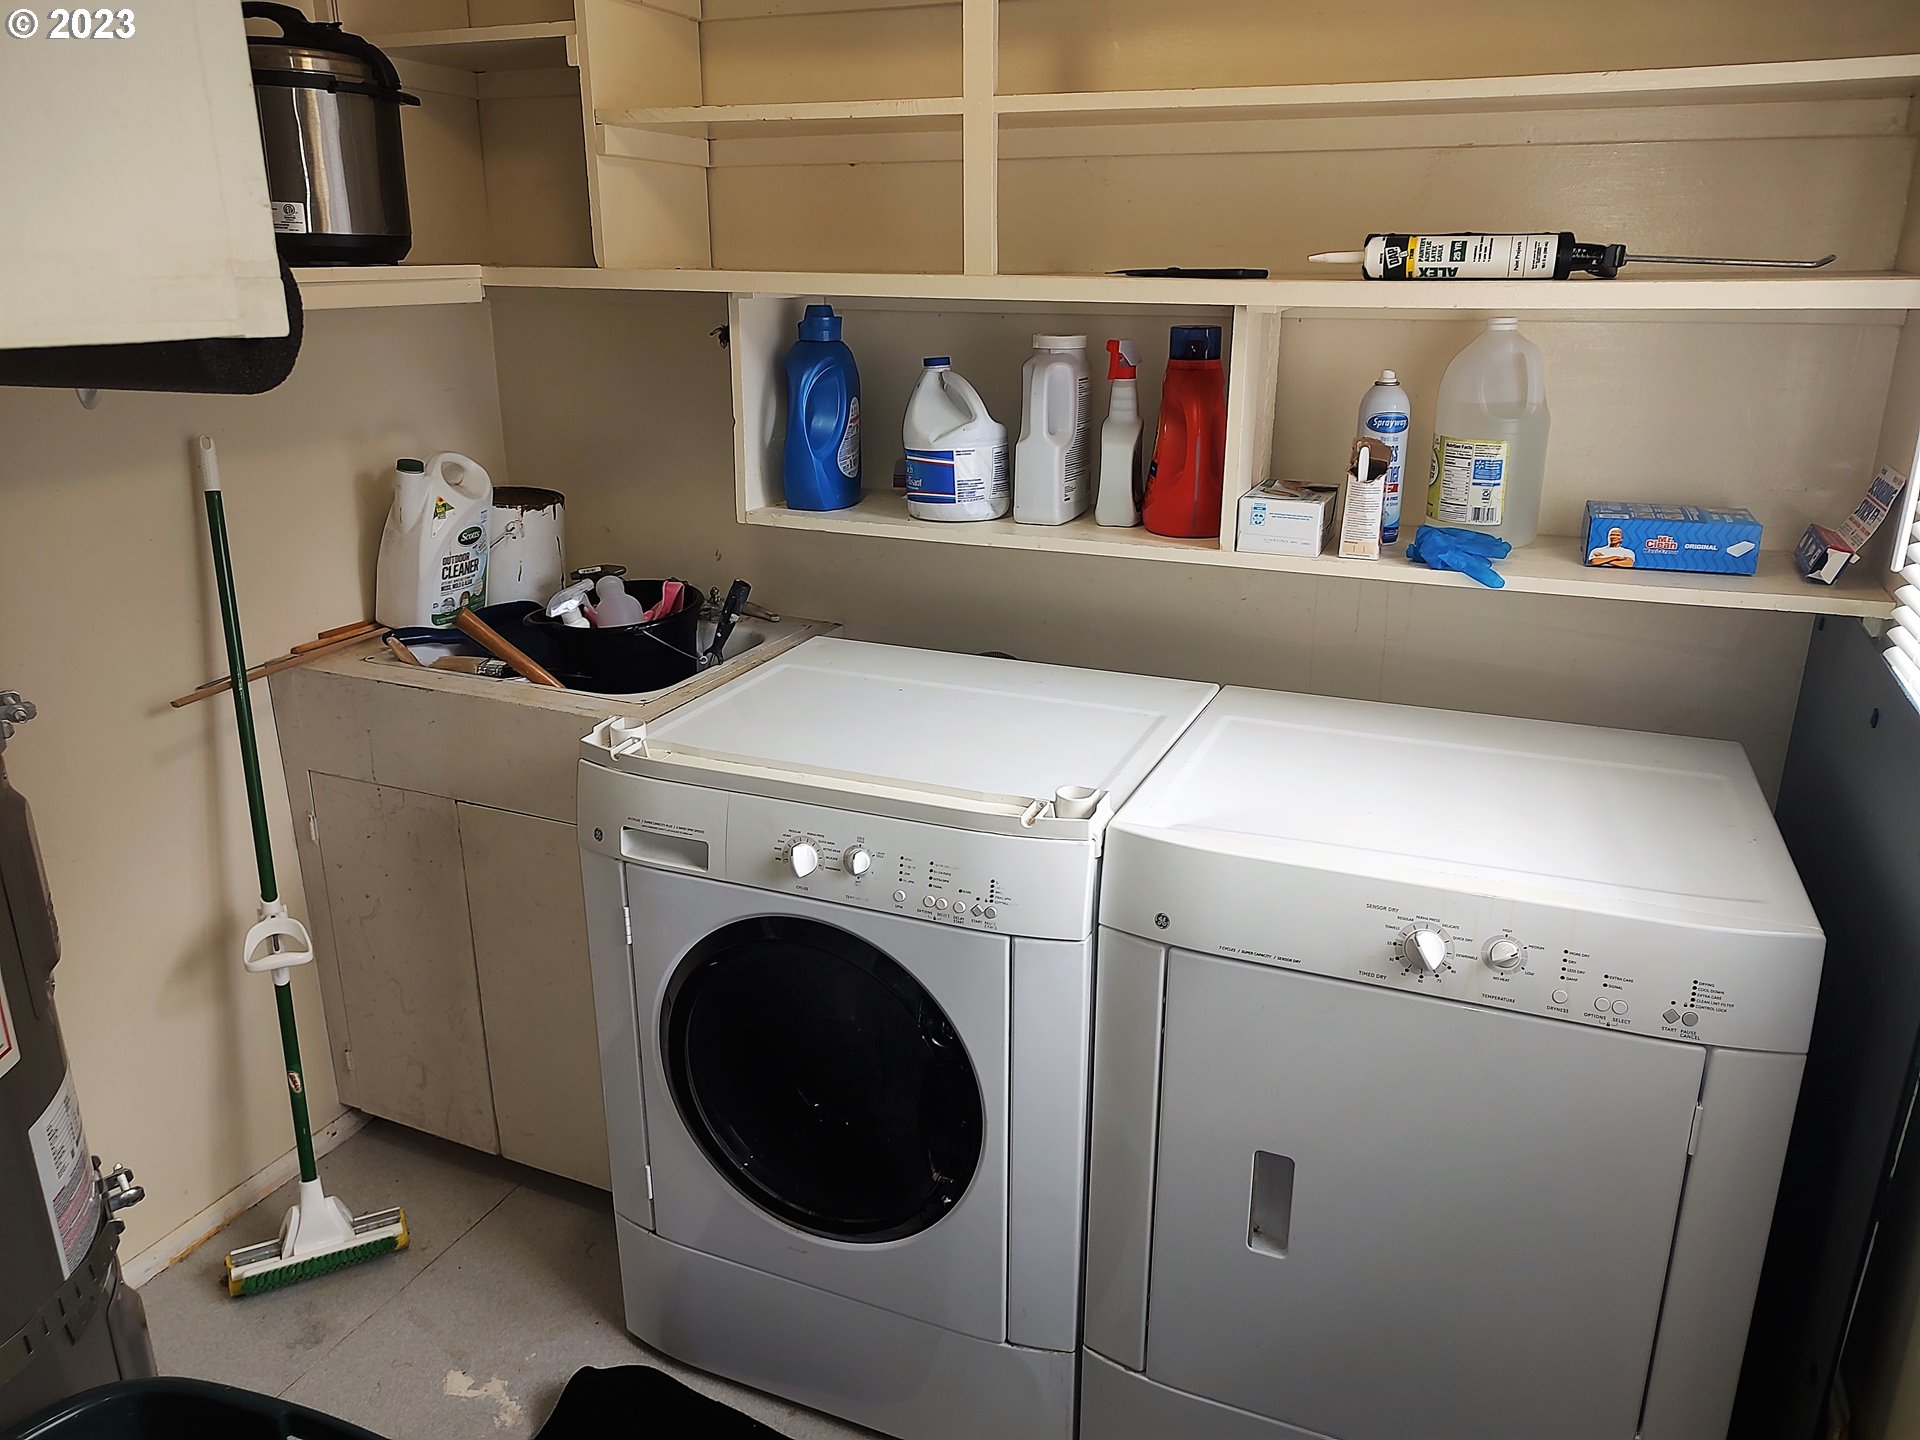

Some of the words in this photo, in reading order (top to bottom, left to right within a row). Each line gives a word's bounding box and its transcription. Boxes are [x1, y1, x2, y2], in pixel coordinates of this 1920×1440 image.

[1454, 251, 1461, 260] 25
[1419, 267, 1458, 278] ALEX
[1373, 418, 1407, 428] Sprayway
[1646, 539, 1678, 550] Clean
[442, 552, 470, 565] OUTDOOR
[442, 558, 479, 580] CLEANER
[1366, 904, 1387, 912] SENSOR
[1482, 994, 1516, 1004] TEMPERATURE
[1584, 1012, 1606, 1020] OPTIONS
